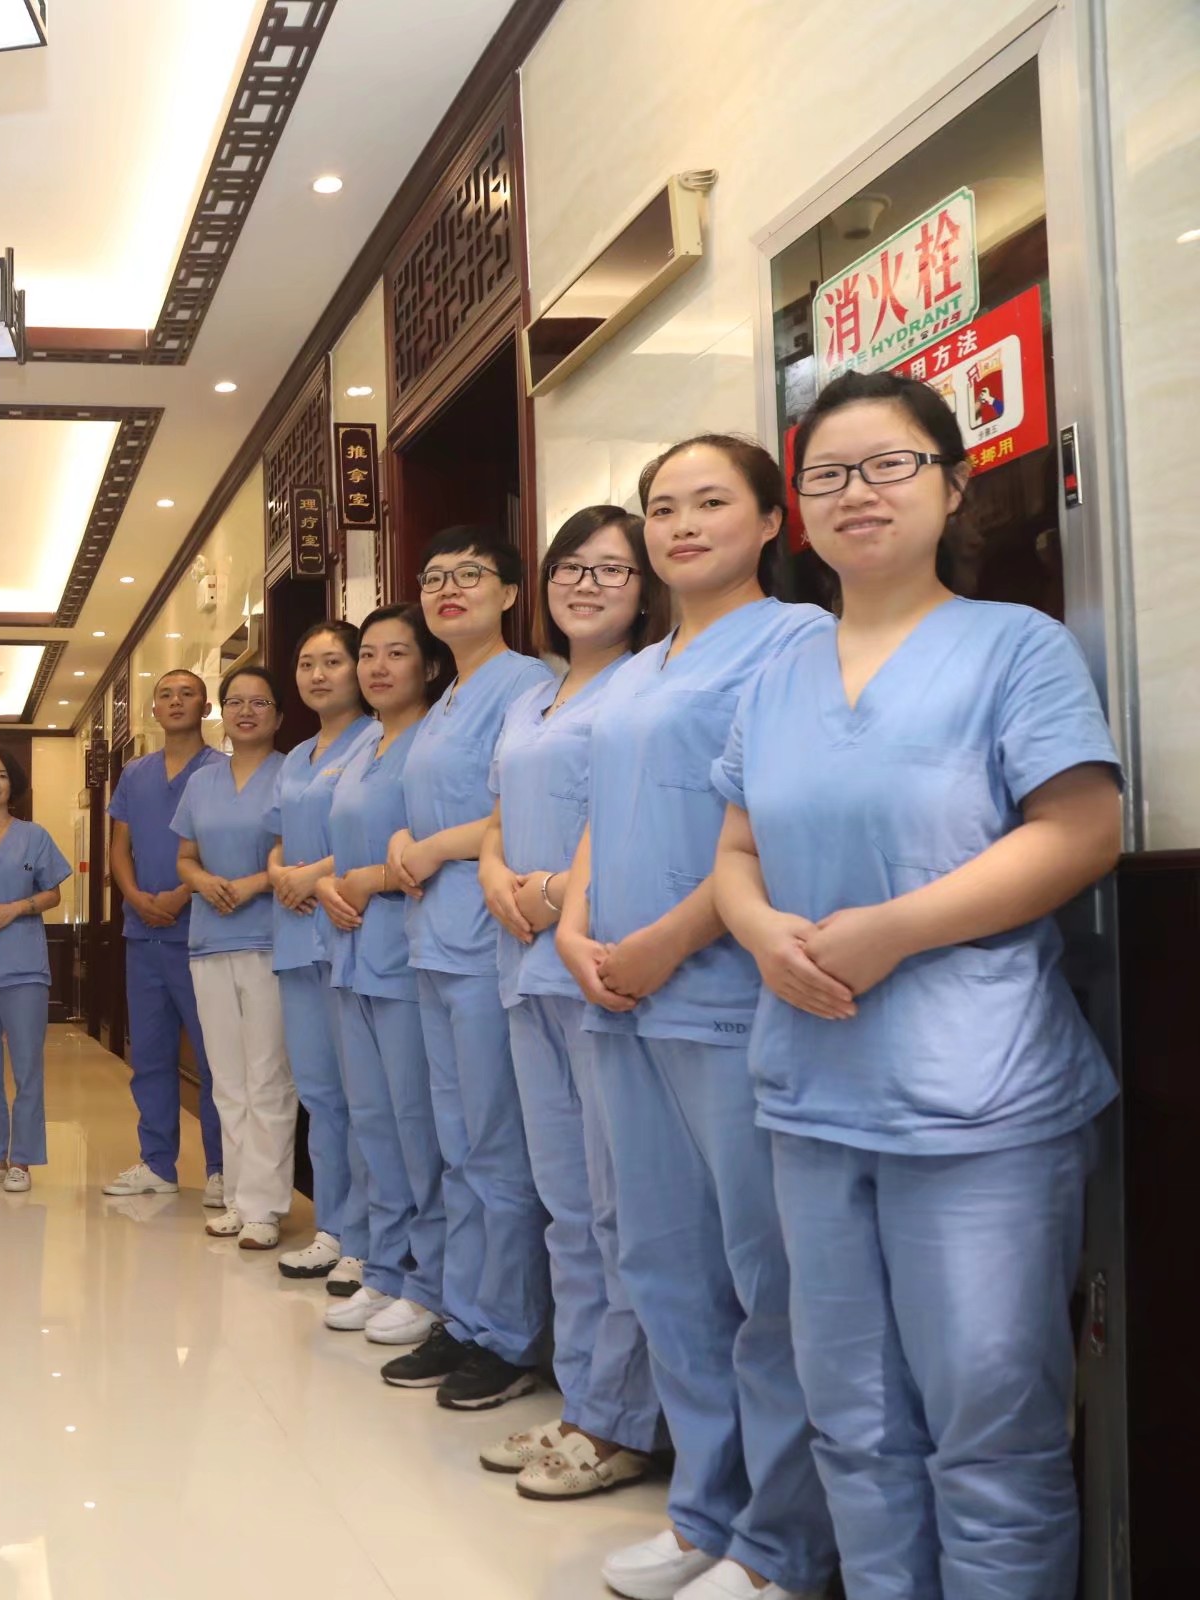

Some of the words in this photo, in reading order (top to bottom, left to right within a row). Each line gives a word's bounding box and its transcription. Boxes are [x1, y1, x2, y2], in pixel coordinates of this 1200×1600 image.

[823, 208, 962, 367] 消火栓
[871, 294, 962, 357] HYDRANT
[895, 329, 978, 381] 用方法
[346, 444, 370, 507] 推拿室
